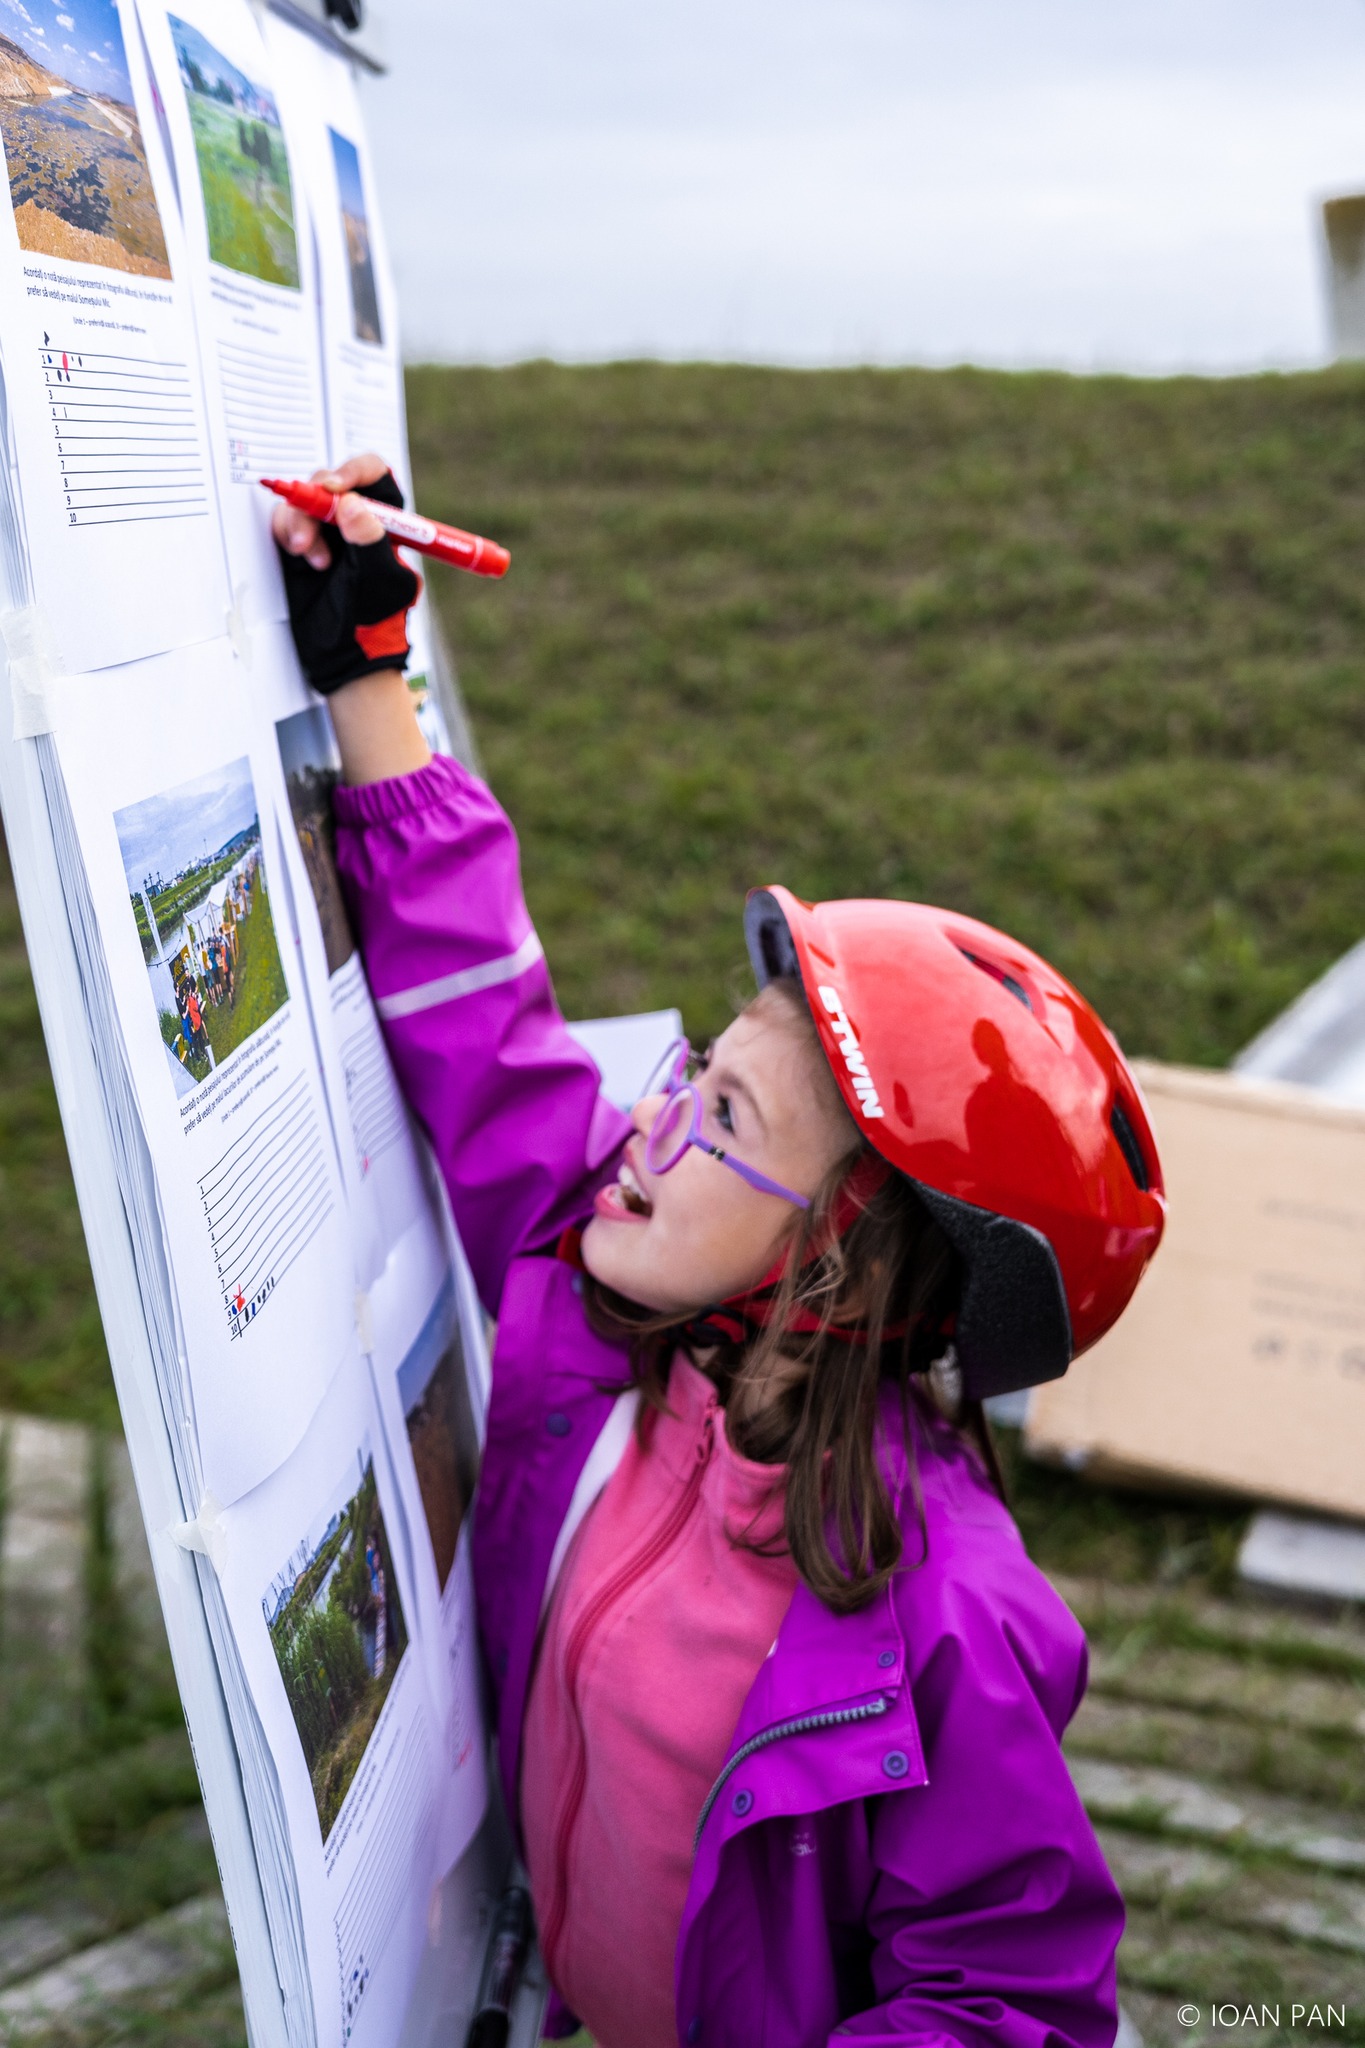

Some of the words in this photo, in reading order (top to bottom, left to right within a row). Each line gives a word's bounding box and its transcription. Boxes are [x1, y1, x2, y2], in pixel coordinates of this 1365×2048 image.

[42, 355, 46, 364] 1
[45, 373, 49, 382] 2
[49, 390, 53, 399] 3
[52, 408, 56, 417] 4
[55, 425, 59, 435] 5
[59, 443, 62, 452] 6
[61, 461, 65, 470] 7
[64, 478, 68, 488] 8
[67, 496, 71, 505] 9
[70, 513, 77, 523] 10
[200, 1186, 205, 1195] 1
[204, 1201, 208, 1210] 2
[207, 1217, 211, 1226] 3
[211, 1233, 215, 1241] 4
[214, 1248, 219, 1258] 5
[218, 1264, 222, 1273] 6
[221, 1280, 225, 1288] 7
[225, 1295, 229, 1304] 8
[228, 1311, 232, 1320] 9
[231, 1324, 238, 1335] 10
